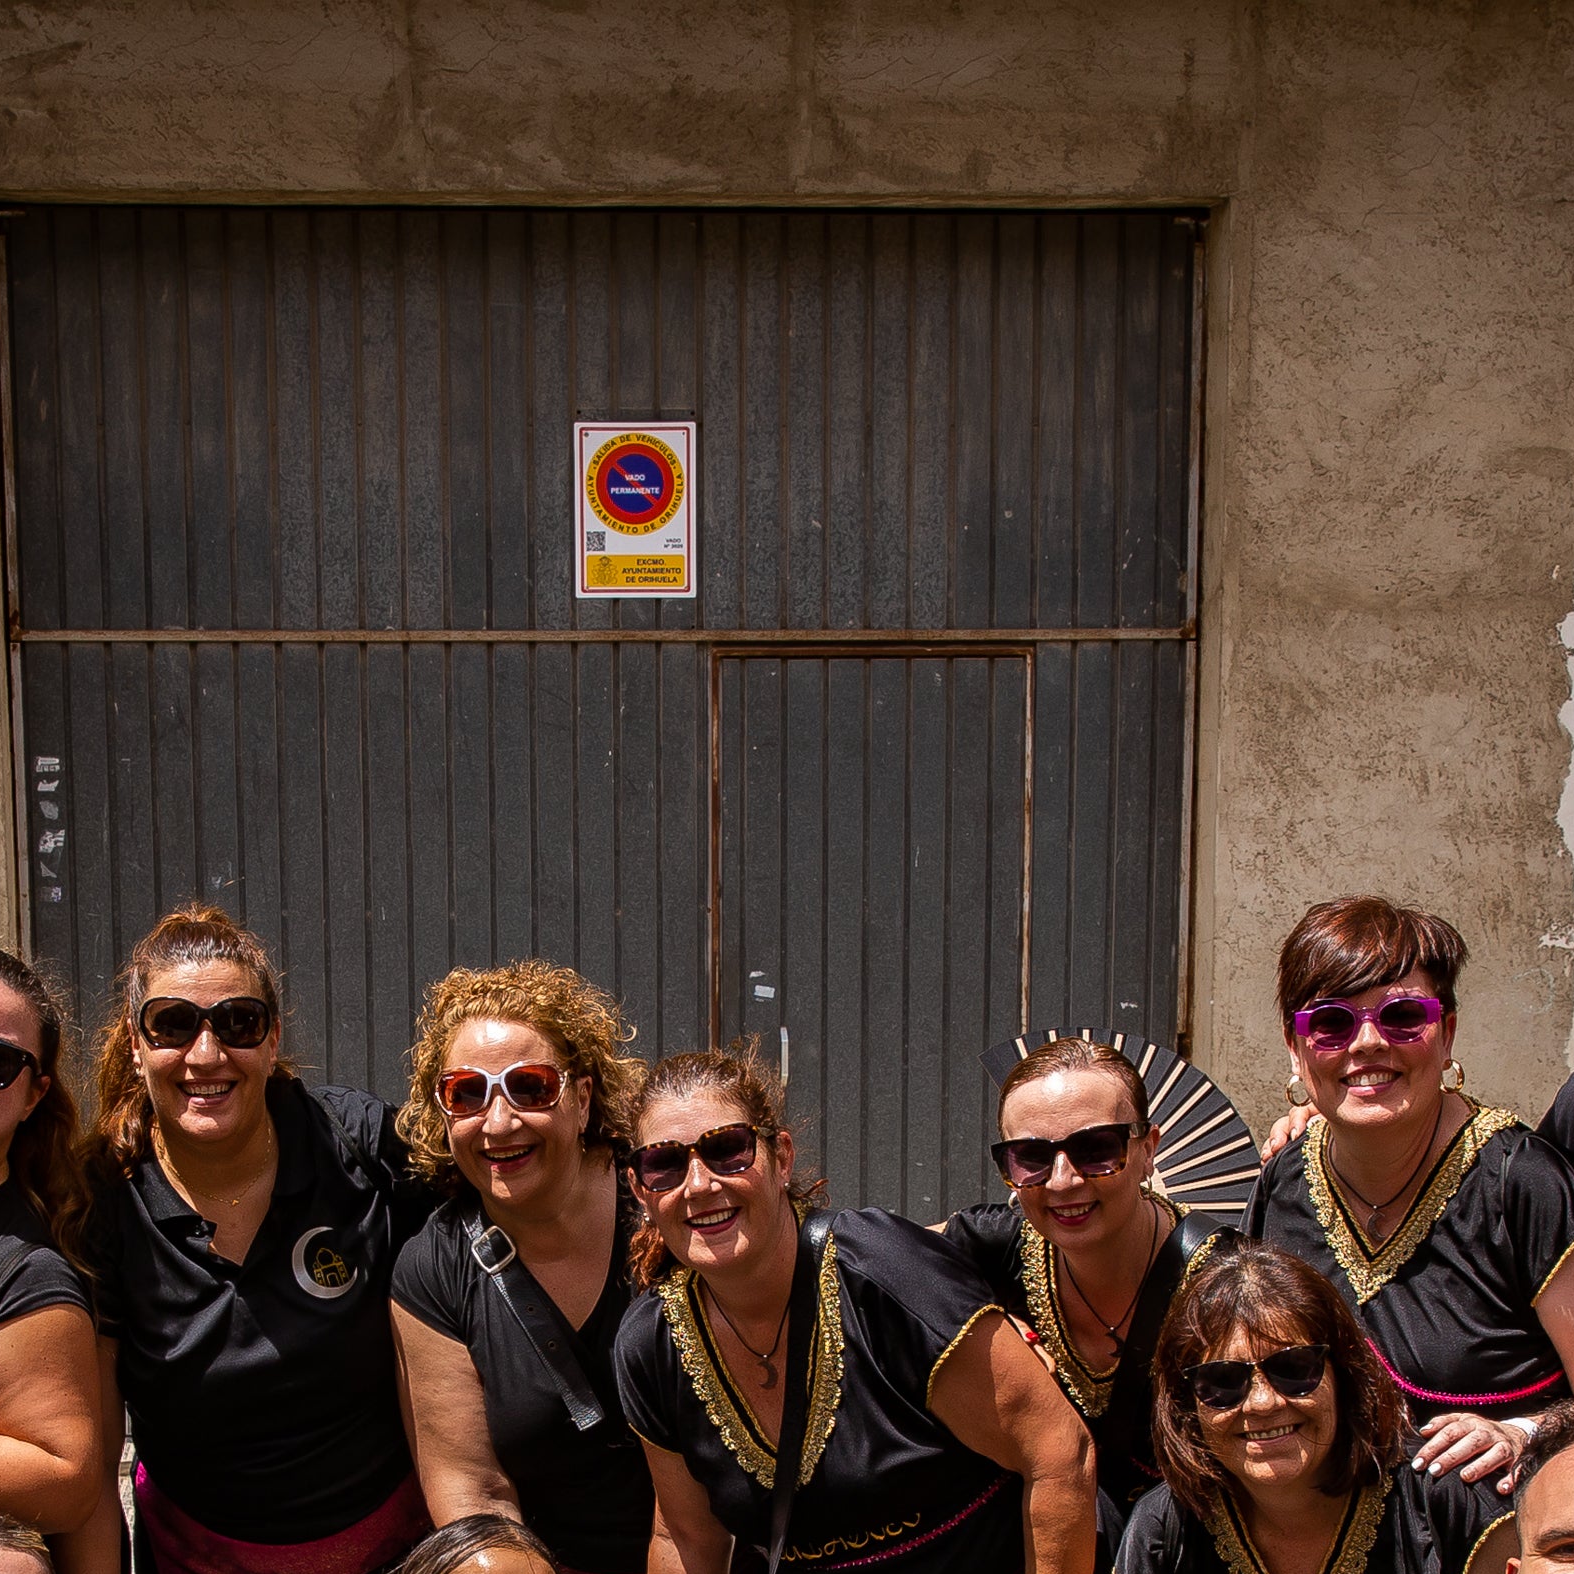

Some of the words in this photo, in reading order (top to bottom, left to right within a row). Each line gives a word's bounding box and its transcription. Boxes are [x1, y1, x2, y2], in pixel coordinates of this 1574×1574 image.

[593, 439, 617, 465] SALIDA
[620, 434, 633, 443] DE
[636, 434, 677, 465] VEHICULOS
[587, 475, 638, 534] AYUNTAMIENTO
[643, 523, 657, 533] DE
[660, 473, 684, 524] ORIHUELA
[611, 487, 660, 495] PERMANENTE
